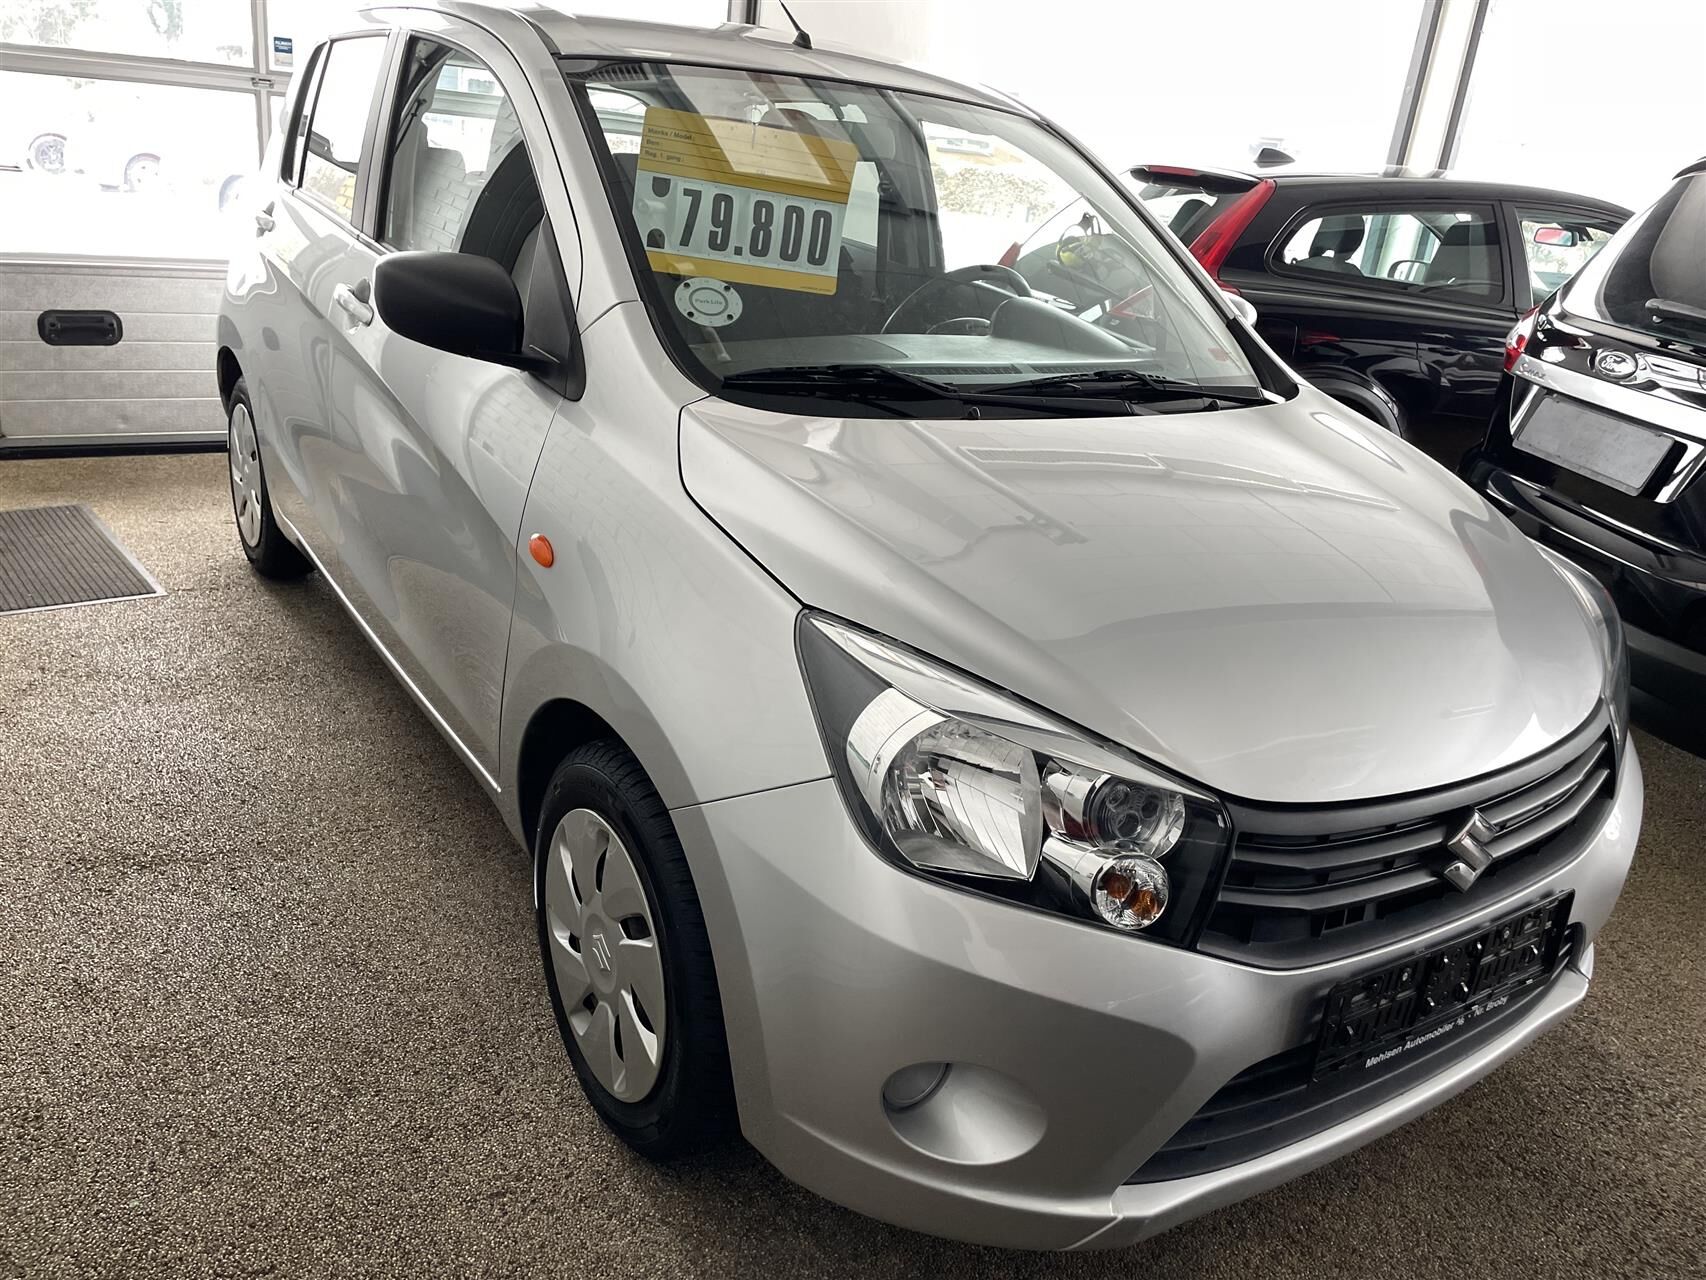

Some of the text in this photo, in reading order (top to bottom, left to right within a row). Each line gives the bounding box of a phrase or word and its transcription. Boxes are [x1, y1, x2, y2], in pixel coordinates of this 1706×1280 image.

[679, 187, 833, 266] 79.800
[1365, 1046, 1403, 1069] Mehlsen
[1403, 1022, 1456, 1051] Automobiler
